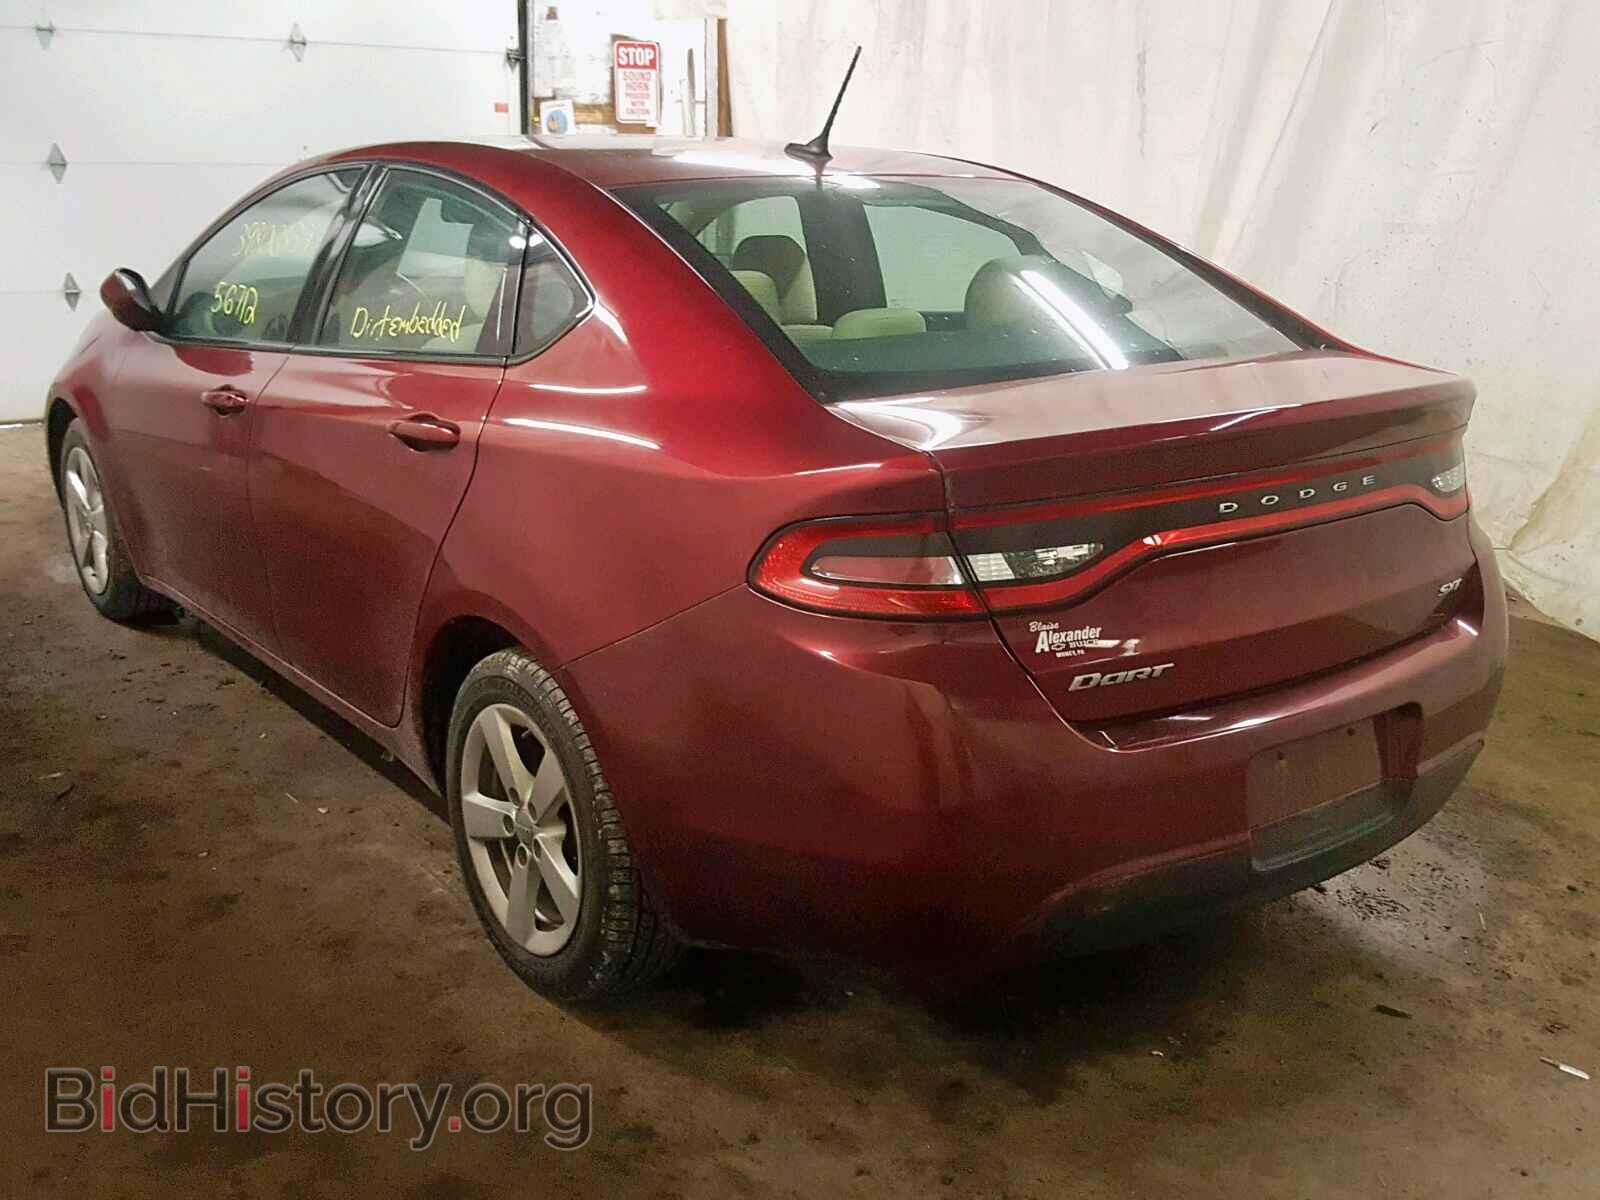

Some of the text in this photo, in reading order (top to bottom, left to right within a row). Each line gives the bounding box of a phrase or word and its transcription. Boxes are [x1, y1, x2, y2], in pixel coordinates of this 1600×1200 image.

[618, 47, 655, 66] STOP
[1219, 475, 1376, 513] DODGE
[1035, 625, 1102, 653] Alexander
